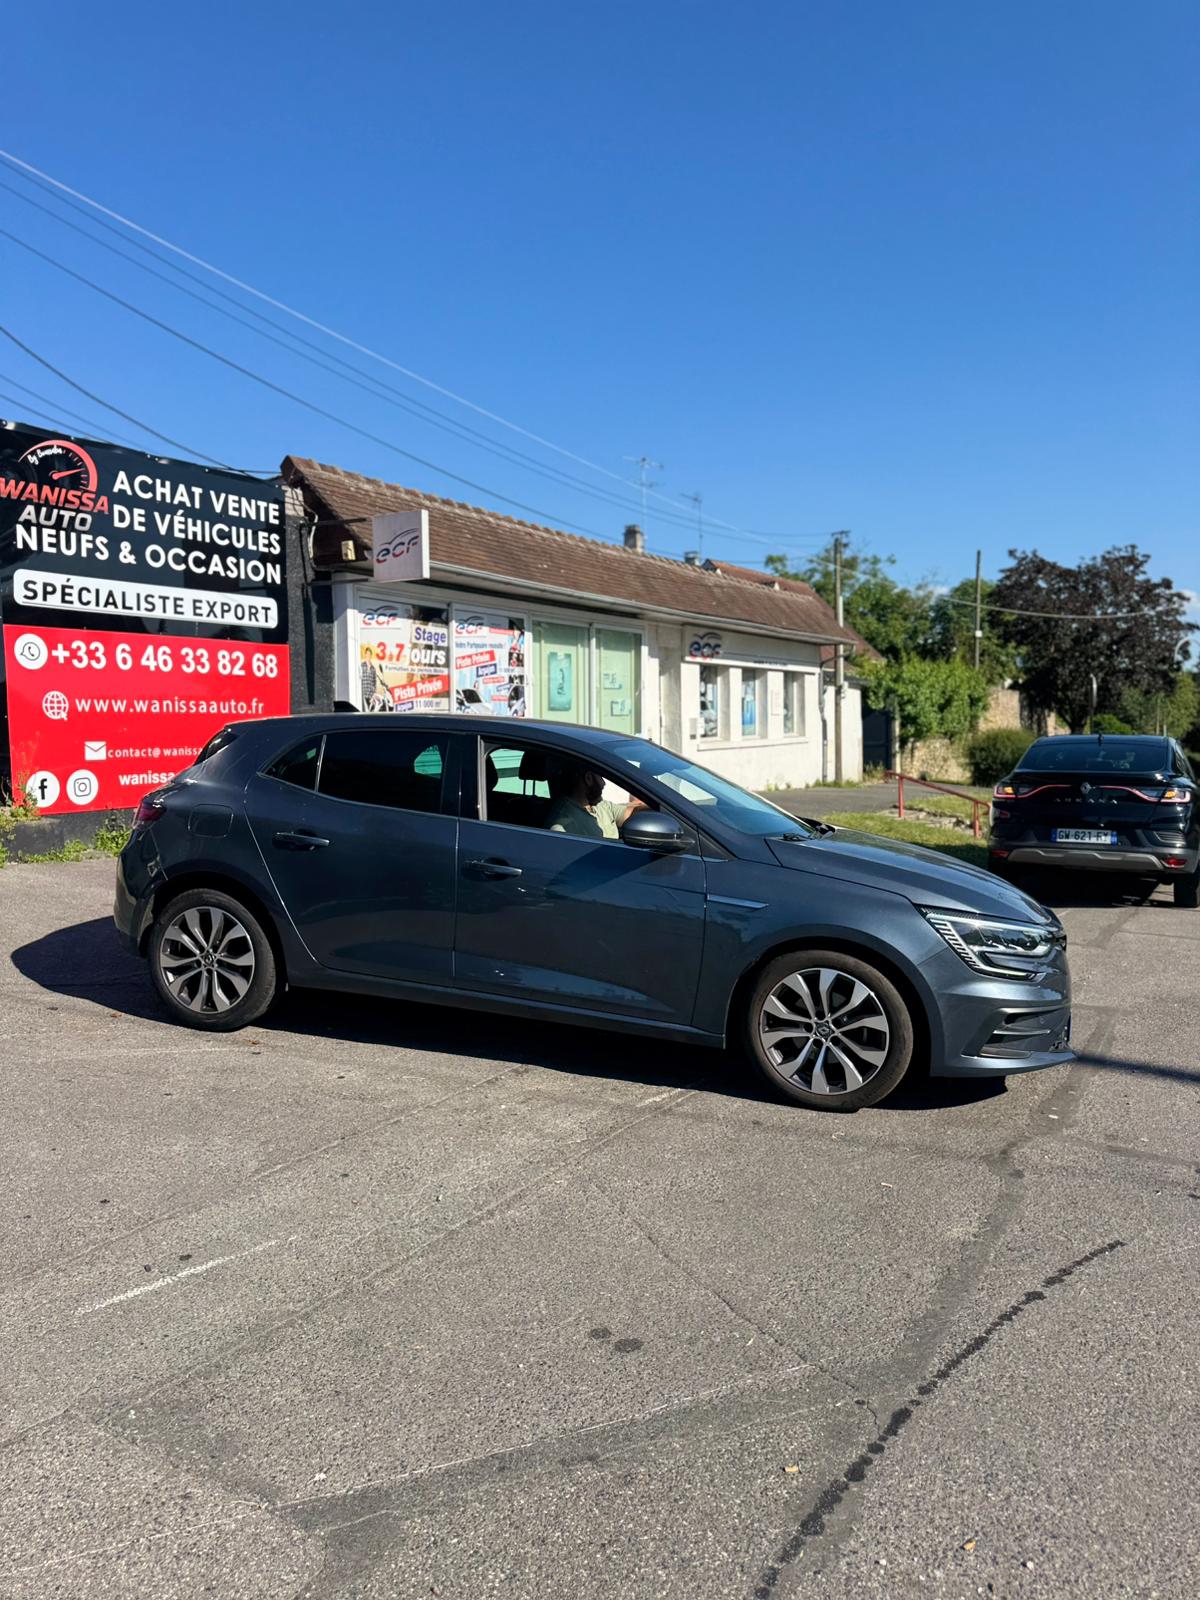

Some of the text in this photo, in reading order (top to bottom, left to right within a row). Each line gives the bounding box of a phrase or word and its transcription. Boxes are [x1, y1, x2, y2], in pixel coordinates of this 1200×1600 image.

[0, 477, 109, 515] WANISSA
[112, 470, 280, 525] ACHAT VENTE
[18, 504, 92, 532] AUTO
[113, 504, 281, 555] DE VÉHICULES
[15, 523, 281, 585] NEUFS & OCCASION
[23, 577, 272, 623] SPÉCIALISTE EXPORT
[415, 626, 447, 645] Stage
[51, 640, 278, 678] +33 6 46 33 82 68
[75, 696, 264, 715] www.wanissaauto.fr
[394, 687, 416, 701] Piste
